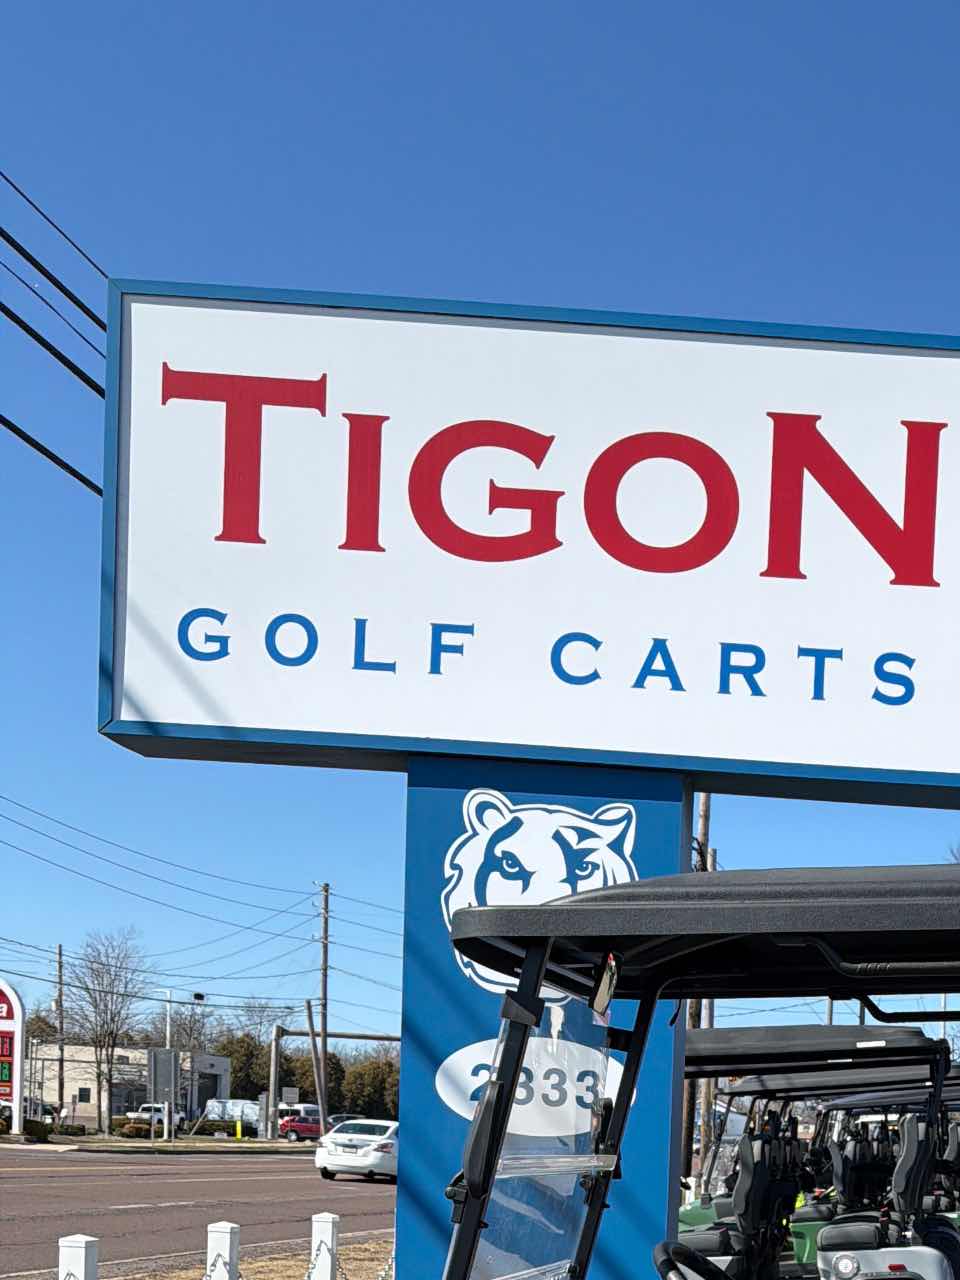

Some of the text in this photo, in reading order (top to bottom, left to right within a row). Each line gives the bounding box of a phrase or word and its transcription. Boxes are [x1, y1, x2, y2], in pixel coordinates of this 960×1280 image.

[161, 361, 948, 587] TIGON
[176, 607, 916, 707] GOLF CARTS
[469, 1062, 601, 1110] 2333
